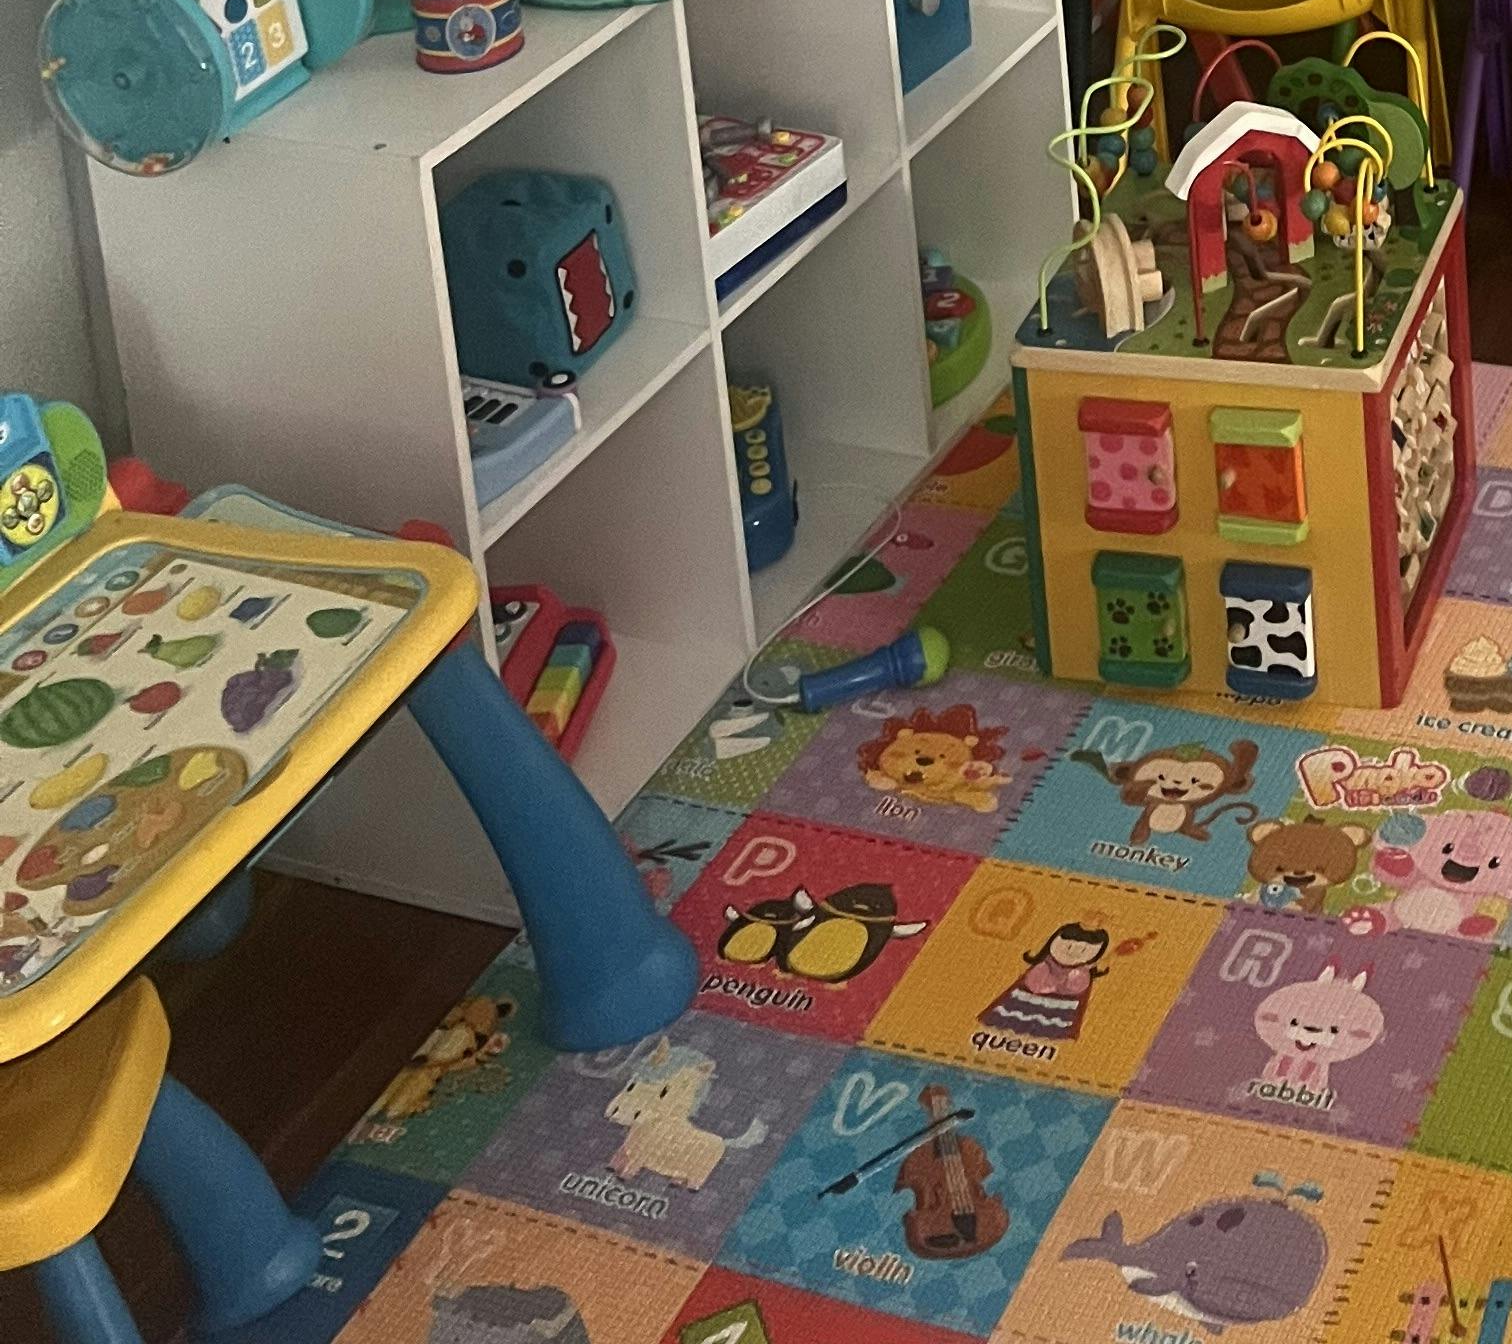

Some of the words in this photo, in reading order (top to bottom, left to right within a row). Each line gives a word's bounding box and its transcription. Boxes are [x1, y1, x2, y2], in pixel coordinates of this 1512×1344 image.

[241, 41, 257, 70] 2
[937, 293, 960, 308] 2
[1414, 712, 1451, 733] ice
[722, 836, 797, 887] P
[1090, 839, 1191, 872] monkey
[1218, 928, 1295, 989] R
[699, 971, 816, 1012] penguin
[970, 1028, 1059, 1062] queen
[1244, 1079, 1338, 1109] rabbit
[558, 1170, 669, 1221] unicorn
[832, 1245, 915, 1287] violin
